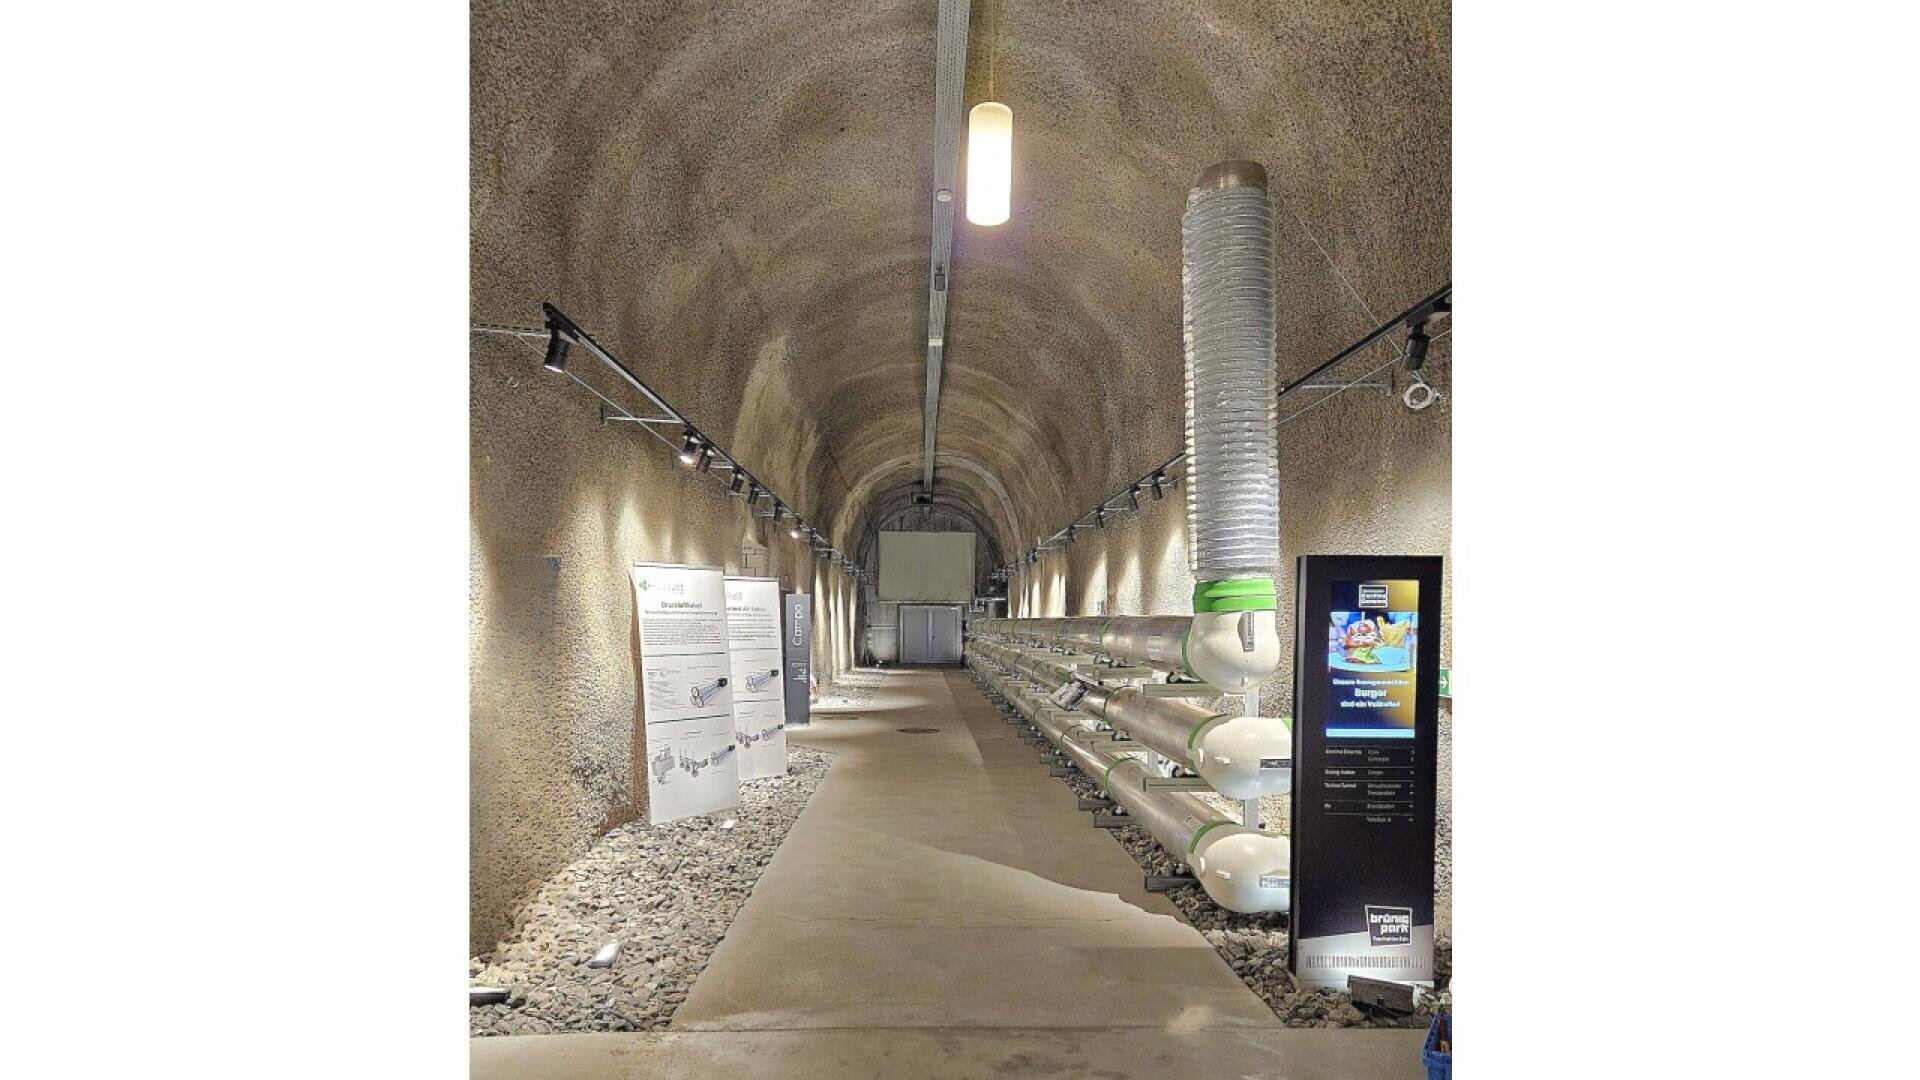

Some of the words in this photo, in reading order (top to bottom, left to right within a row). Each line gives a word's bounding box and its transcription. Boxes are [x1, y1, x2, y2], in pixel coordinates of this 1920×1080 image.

[792, 604, 804, 646] Campo
[1354, 688, 1387, 700] Burger
[1371, 912, 1409, 924] brünig
[1380, 924, 1409, 935] park
